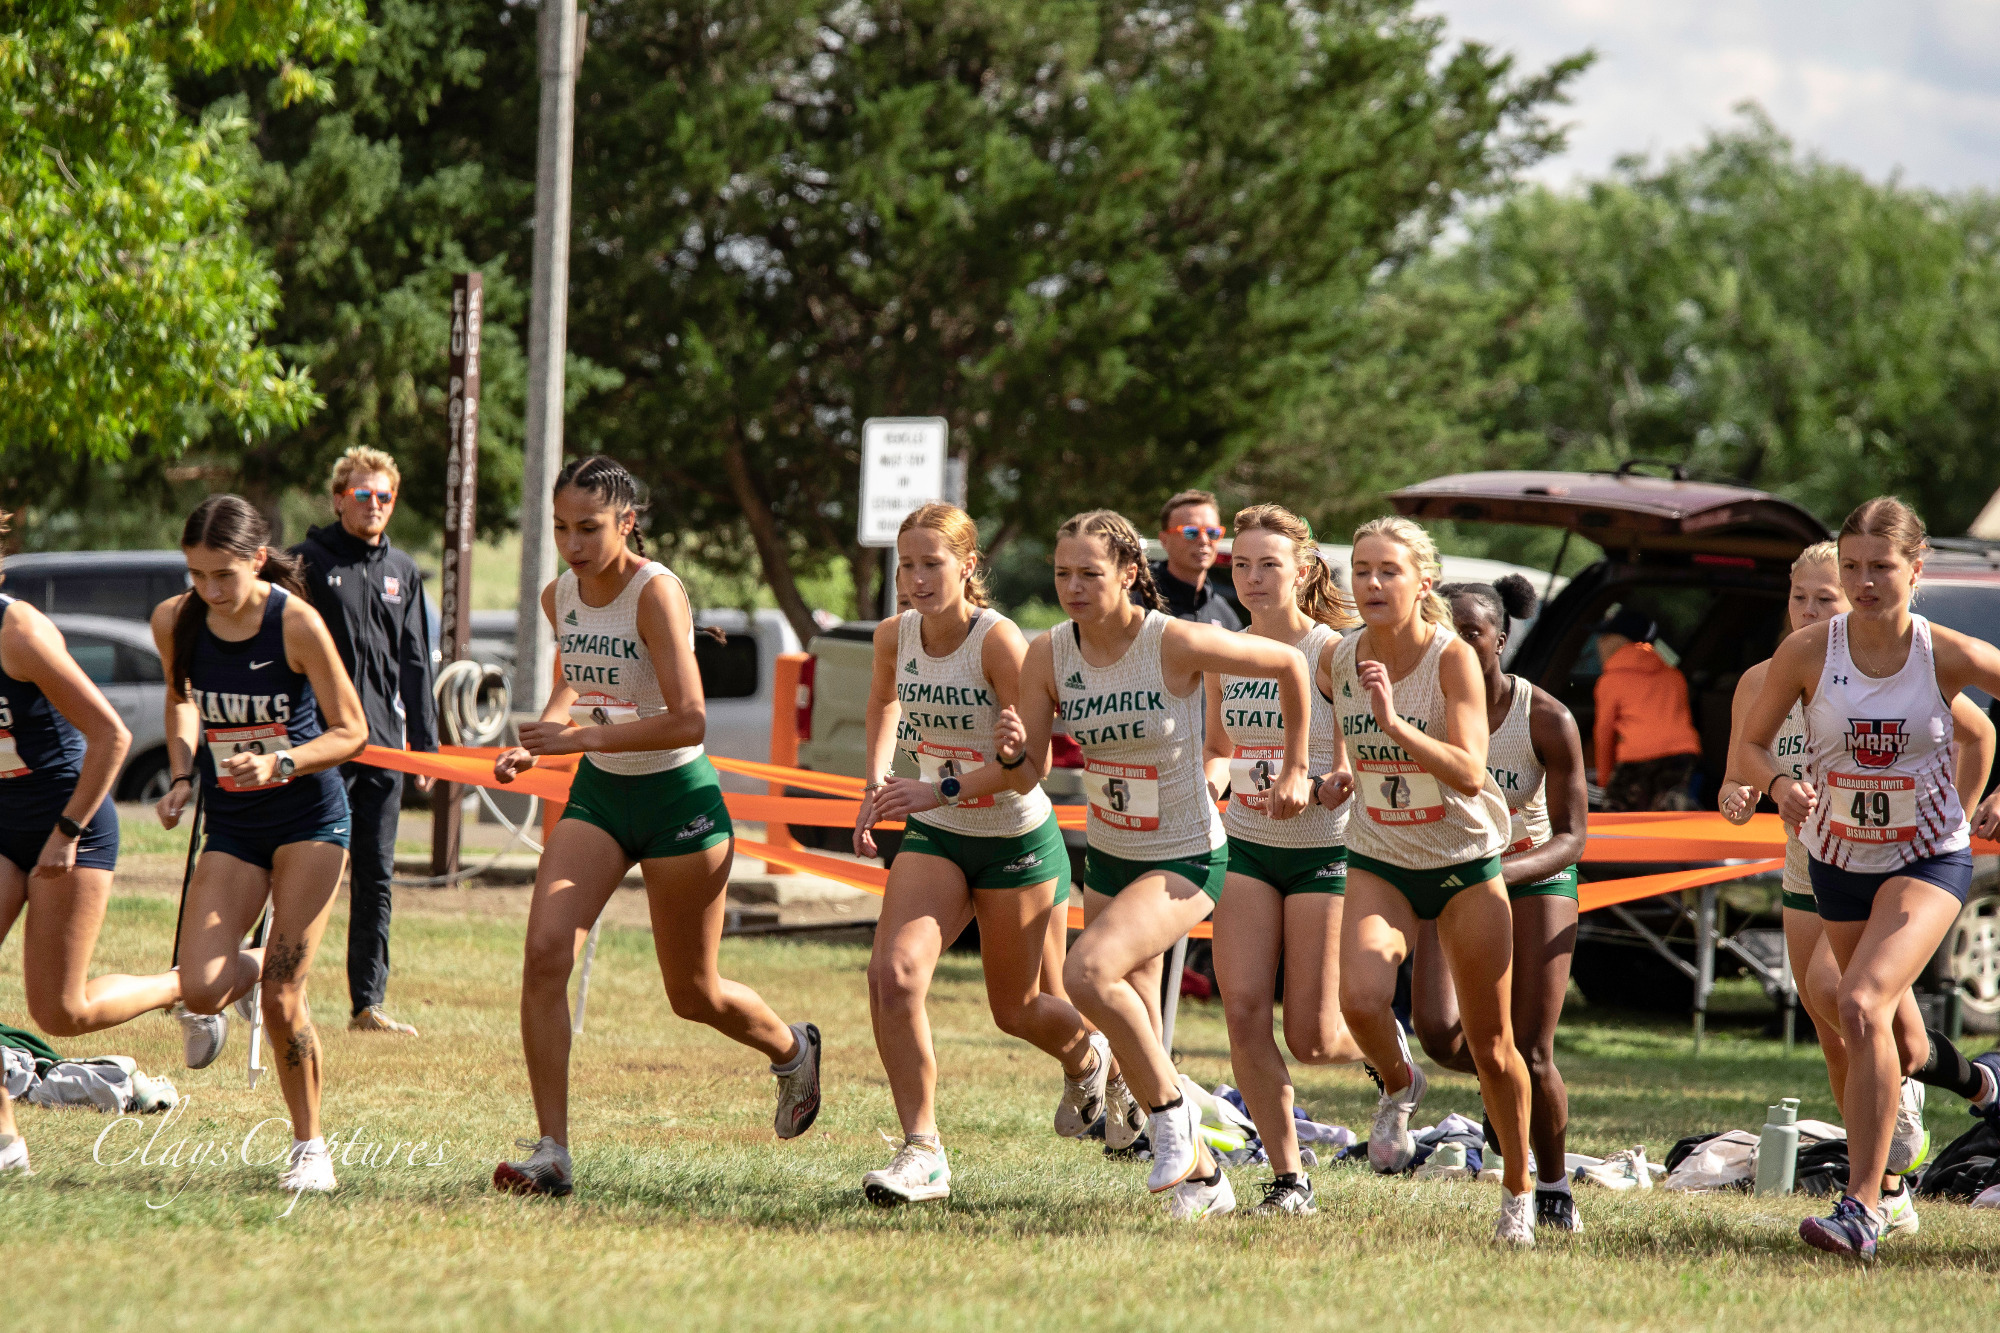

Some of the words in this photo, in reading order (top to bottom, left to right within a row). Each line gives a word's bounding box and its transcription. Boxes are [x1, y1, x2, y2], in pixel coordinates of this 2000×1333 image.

[564, 664, 620, 685] STATE
[898, 683, 993, 706] BISMARCK
[1221, 681, 1280, 701] BISMA
[1060, 691, 1166, 721] BISMARCK
[909, 711, 975, 730] STATE
[1343, 713, 1428, 736] BISMK
[1075, 720, 1146, 746] STATE
[1843, 731, 1911, 754] MARY
[1089, 762, 1124, 777] MARAUDERS
[1125, 767, 1147, 779] INVITE
[1108, 777, 1124, 812] 5
[1384, 775, 1400, 809] 7
[1836, 777, 1880, 790] MARAUDERS
[1880, 780, 1904, 790] INVITE
[1414, 809, 1427, 820] ND
[1850, 791, 1890, 827] 49
[1130, 817, 1142, 829] ND
[1885, 829, 1898, 840] ND
